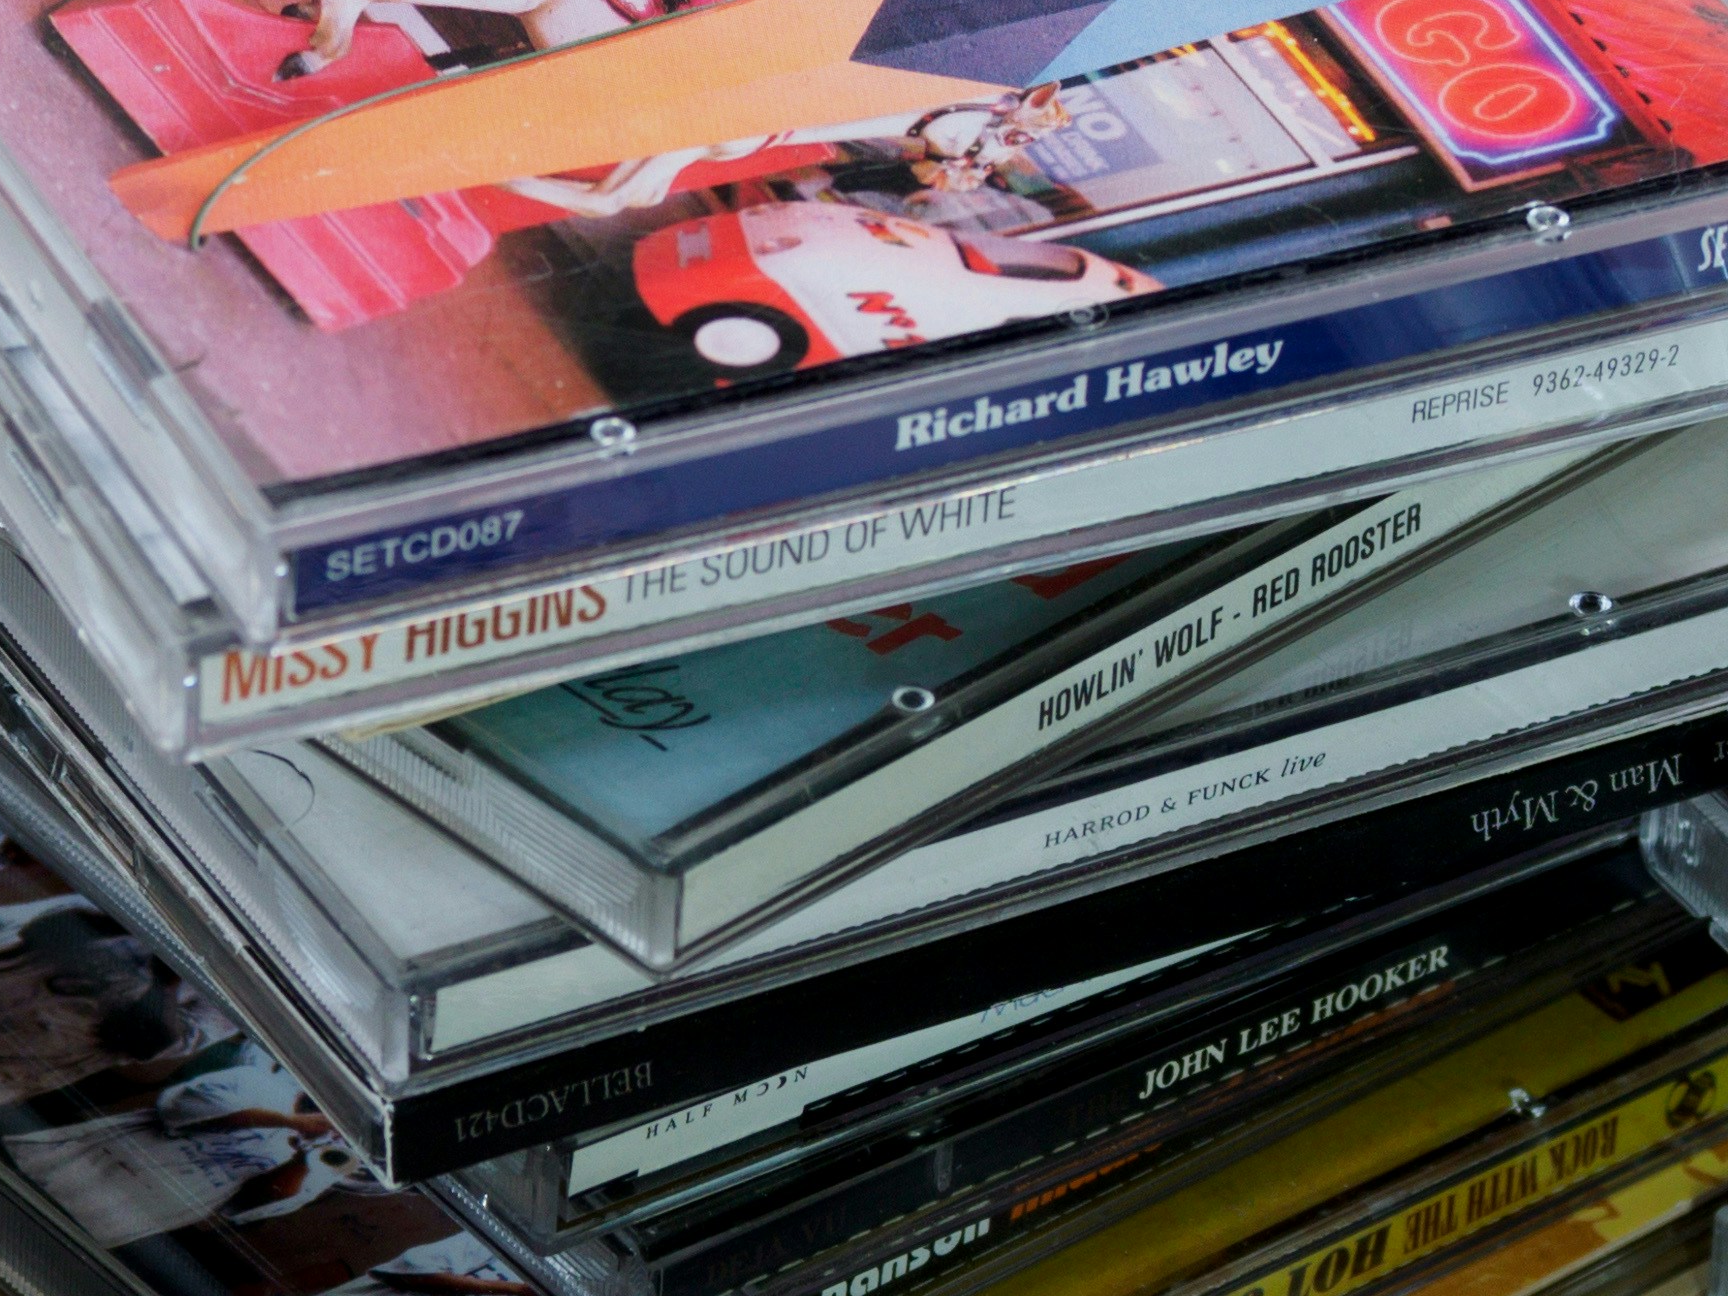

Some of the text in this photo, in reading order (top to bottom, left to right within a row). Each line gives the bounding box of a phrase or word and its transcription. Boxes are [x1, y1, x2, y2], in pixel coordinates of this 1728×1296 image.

[895, 337, 1286, 453] Richard Hawley
[1411, 344, 1681, 424] REPRISE 9362-49329-2
[325, 509, 526, 584] SETCD087
[222, 485, 1018, 705] MISSY HIGGINS THE SOUND OF WHITE
[1038, 647, 1146, 731] HOWLIN'
[1154, 605, 1224, 669] WOLF
[1252, 567, 1301, 618] RED
[1310, 502, 1422, 588] ROOSTER
[1043, 750, 1327, 850] HARROD & FUNCK live
[1565, 780, 1601, 813] &
[1609, 752, 1683, 793] Man
[1472, 790, 1559, 843] Myth
[1137, 945, 1451, 1101] JOHN LEE HOOKER
[454, 1059, 656, 1144] BELLACD421
[645, 1102, 714, 1142] HALF
[1549, 1115, 1621, 1182] ROCK
[1403, 1193, 1458, 1256] THE
[1465, 1153, 1538, 1226] WITH
